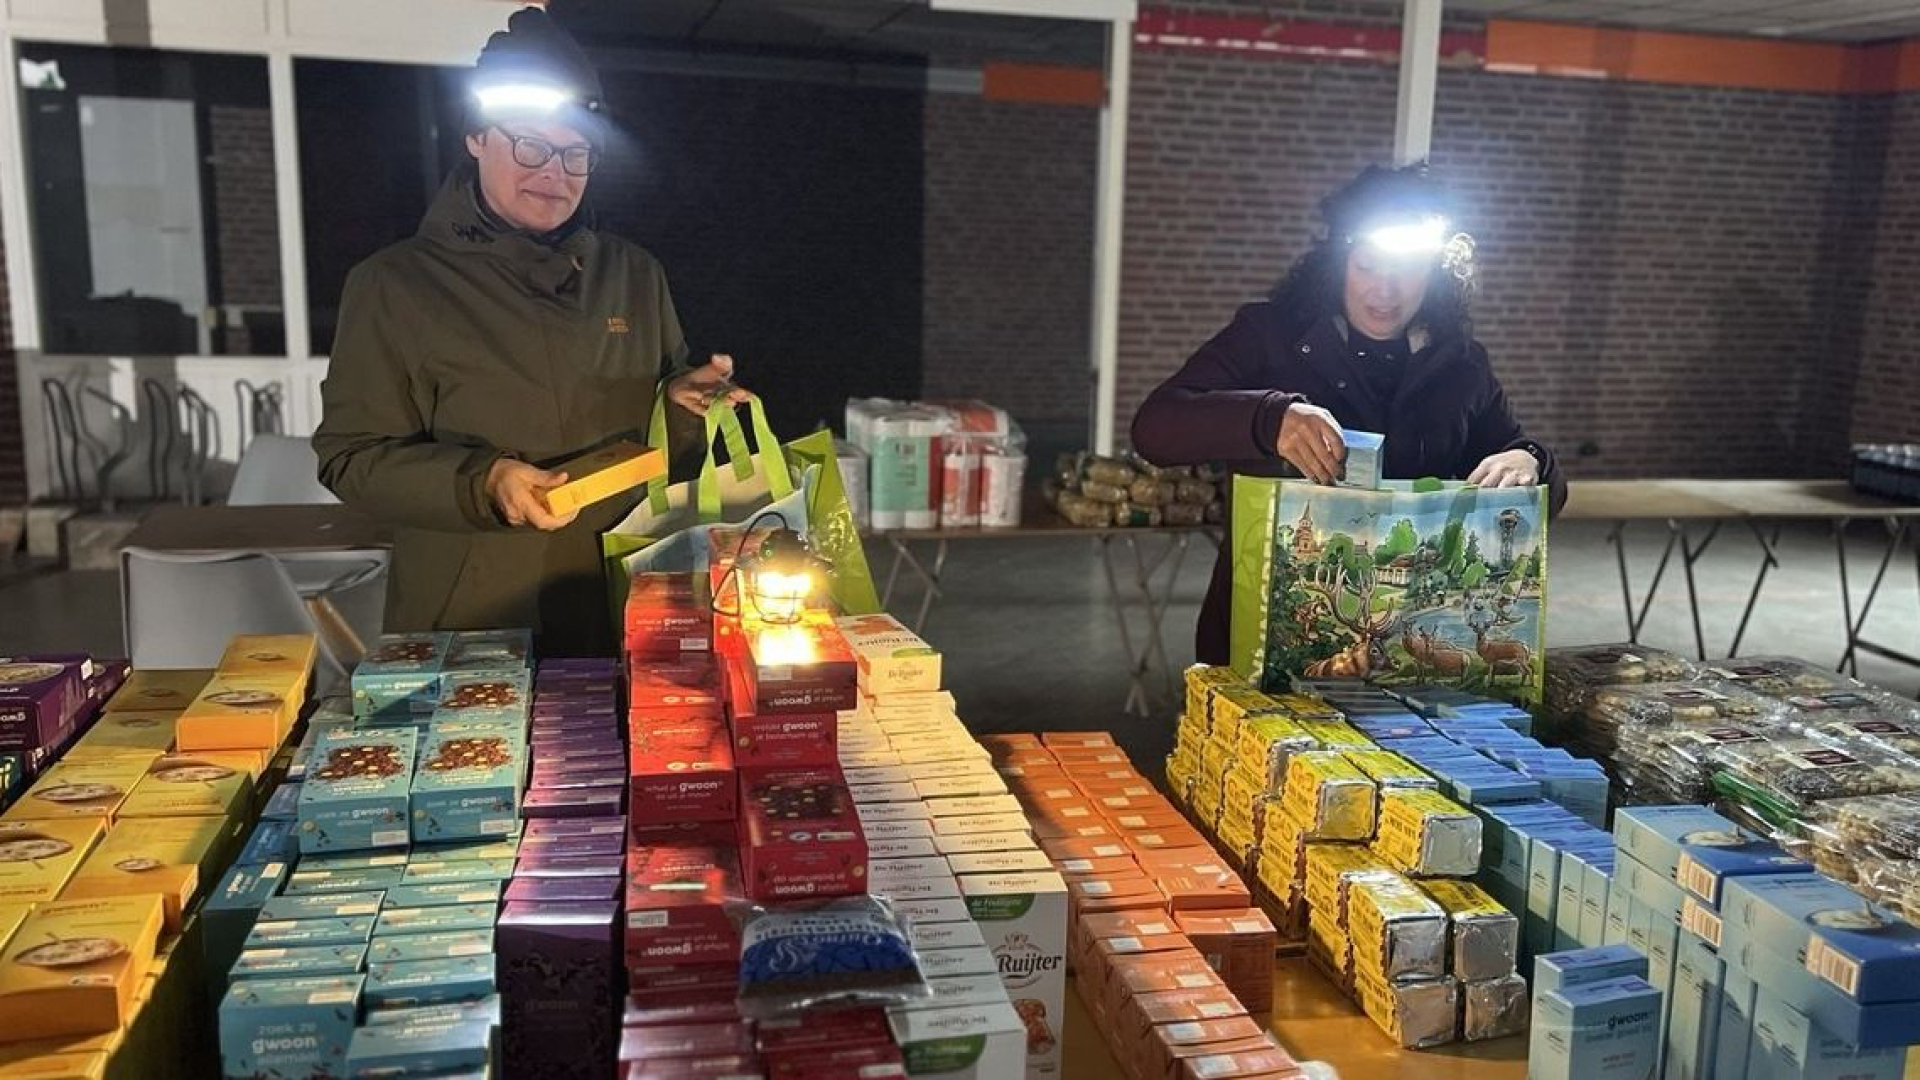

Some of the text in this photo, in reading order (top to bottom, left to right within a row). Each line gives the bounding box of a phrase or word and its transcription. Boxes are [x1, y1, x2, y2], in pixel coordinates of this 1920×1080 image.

[664, 617, 696, 627] gwoon
[783, 721, 818, 732] gwoon
[679, 782, 718, 792] gwoon
[462, 796, 497, 807] gwoon
[352, 807, 389, 818] gwoon
[775, 882, 814, 894] gwoon
[647, 942, 692, 956] gwoon
[996, 951, 1063, 976] Ruijter
[1607, 1011, 1648, 1030] gwoon
[252, 1037, 318, 1054] gwoon
